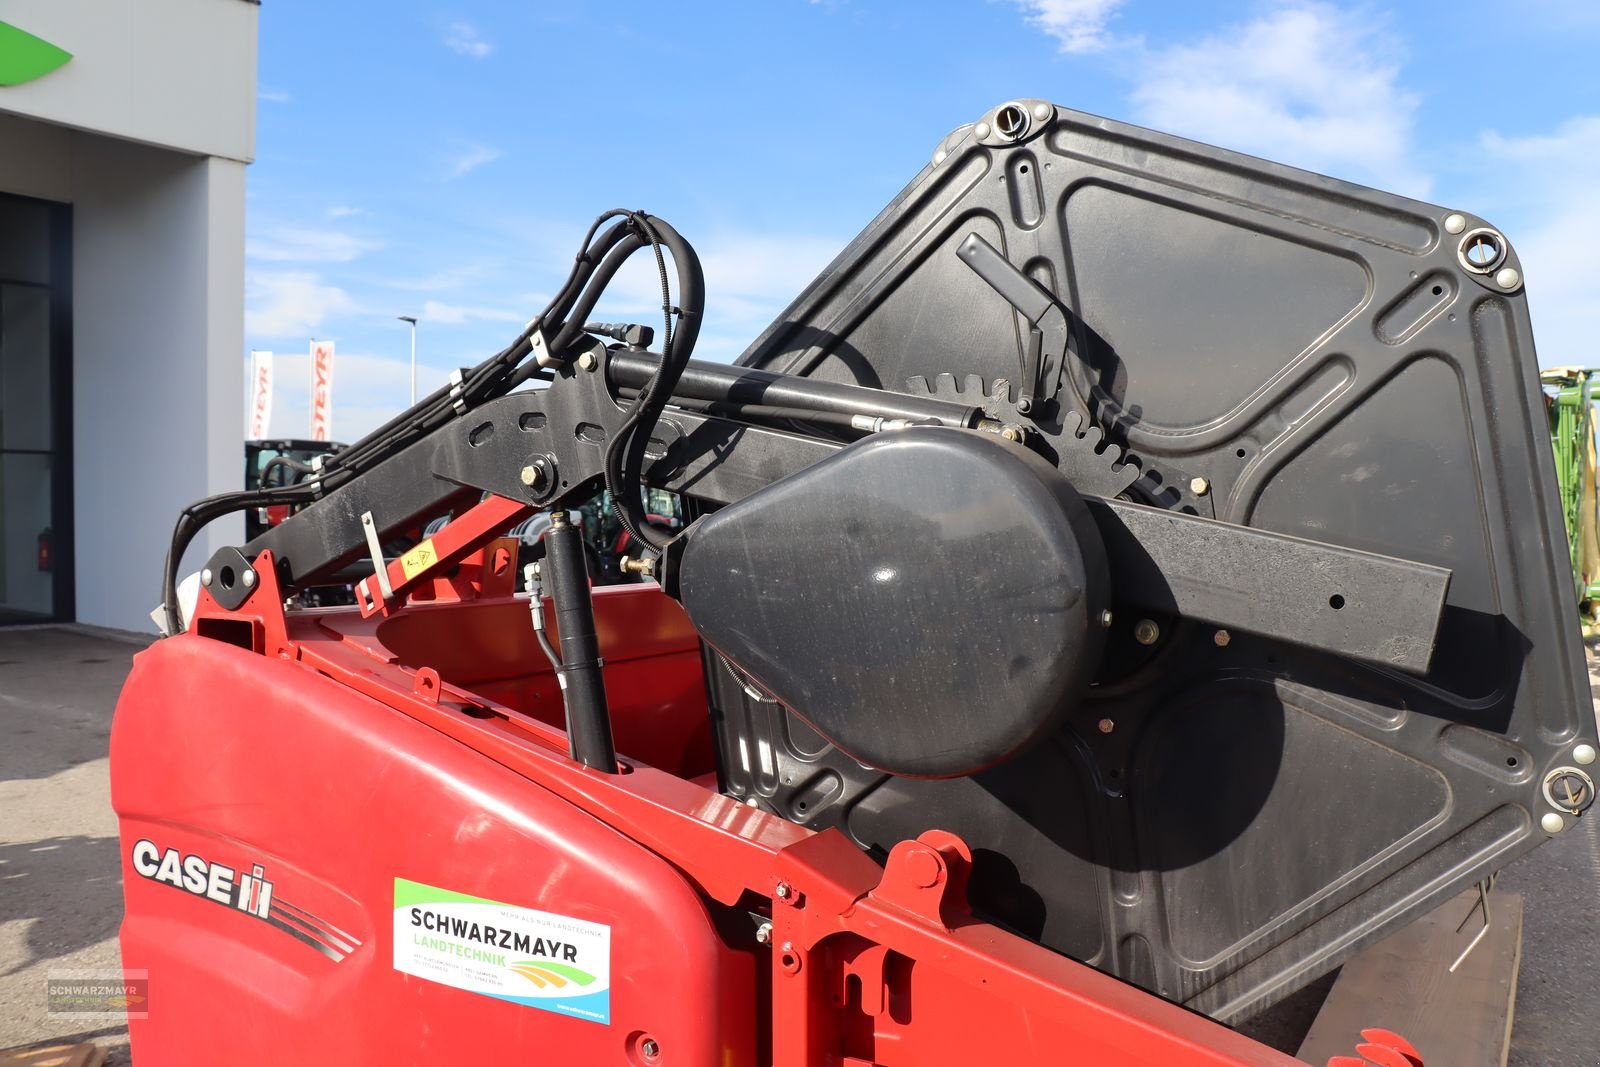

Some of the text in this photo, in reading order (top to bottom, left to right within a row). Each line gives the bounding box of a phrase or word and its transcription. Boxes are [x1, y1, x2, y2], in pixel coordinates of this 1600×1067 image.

[132, 839, 235, 904] CASE
[411, 907, 578, 963] SCHWARZMAYR
[413, 933, 506, 968] LANDTECHNIK
